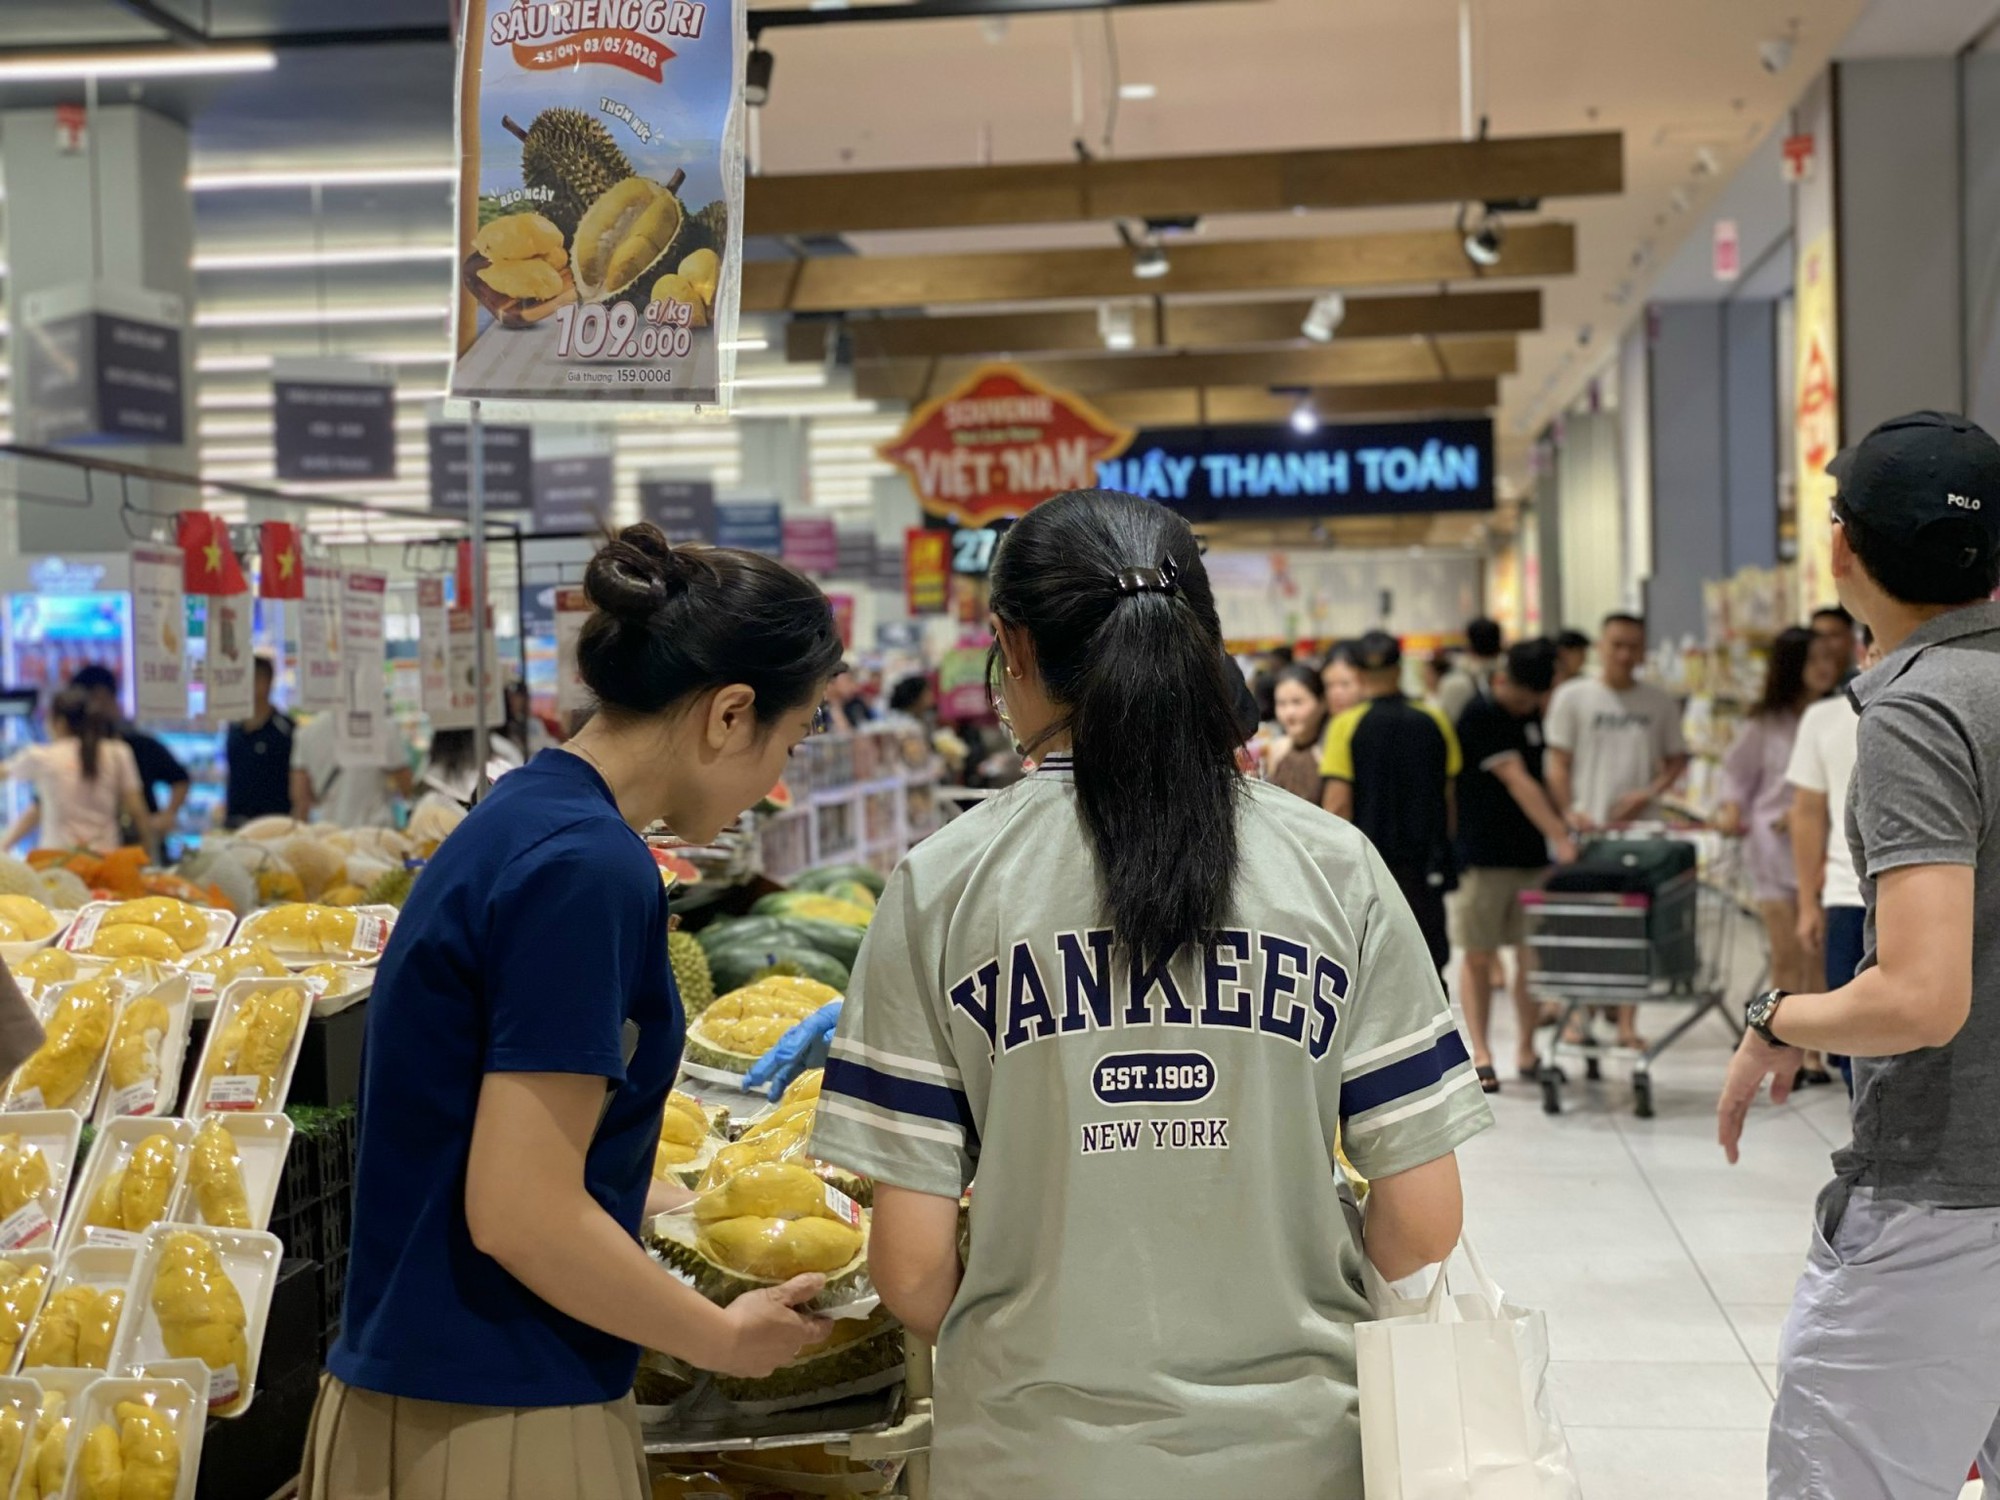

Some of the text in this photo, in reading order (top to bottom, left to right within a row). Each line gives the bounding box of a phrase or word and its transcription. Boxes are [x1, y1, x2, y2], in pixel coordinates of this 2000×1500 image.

[643, 0, 668, 36] 6
[668, 1, 706, 39] RI
[583, 37, 658, 69] 03/05/2026
[524, 184, 555, 204] NGẬY
[617, 369, 671, 383] 159.000đ
[1203, 451, 1351, 498] THANH
[1354, 437, 1479, 494] TOÁN
[1947, 492, 1981, 511] POLO
[948, 927, 1351, 1068] YANKEES
[1100, 1063, 1208, 1091] EST.1903
[1081, 1117, 1230, 1155] NEW YORK
